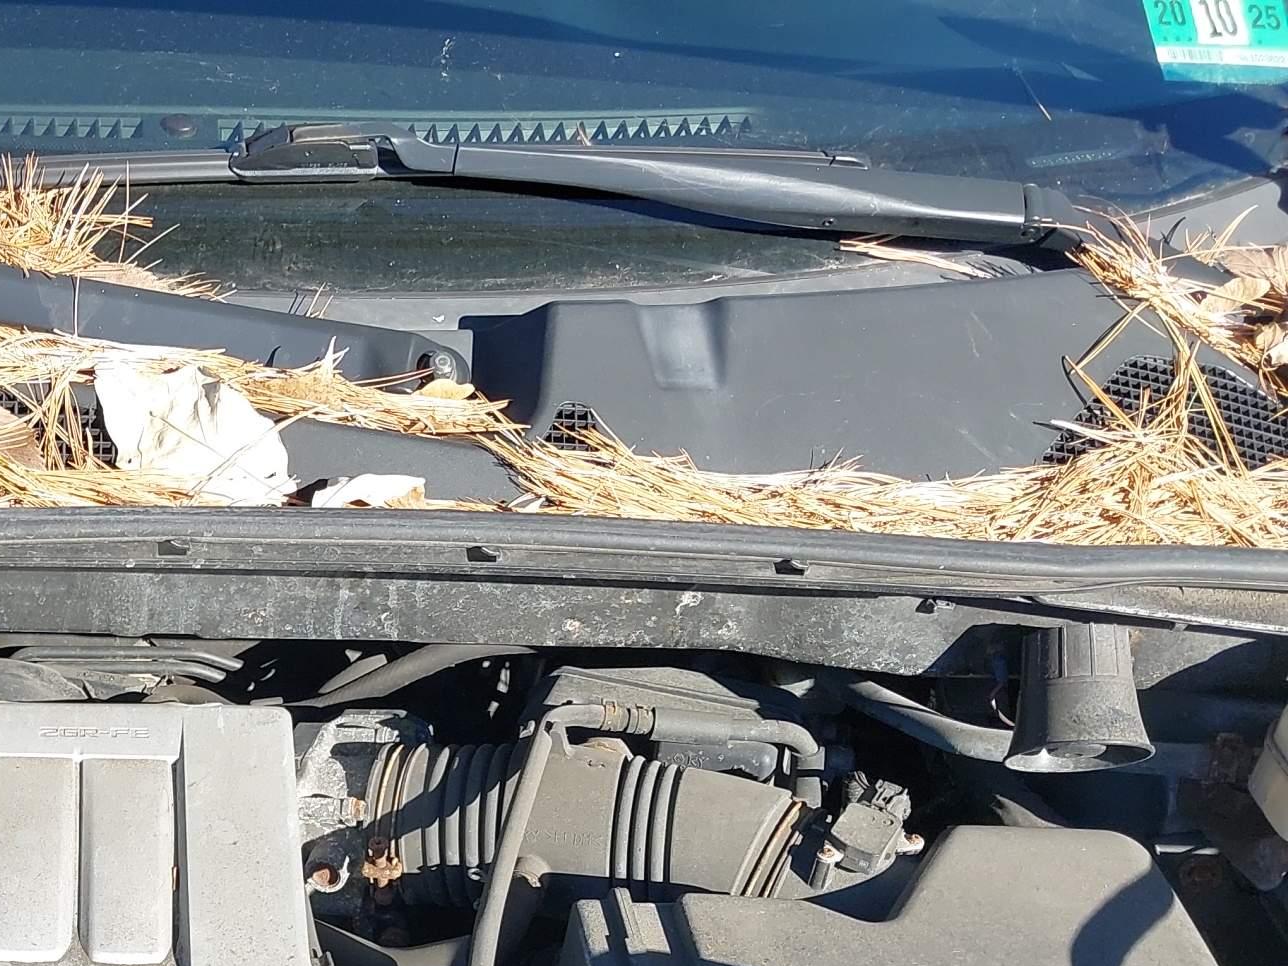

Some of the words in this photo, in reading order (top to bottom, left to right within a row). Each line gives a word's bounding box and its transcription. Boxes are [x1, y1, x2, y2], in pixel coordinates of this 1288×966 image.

[1154, 0, 1186, 26] 20
[1199, 0, 1237, 38] 10
[1247, 4, 1281, 30] 25
[39, 726, 150, 739] 2GR-FE
